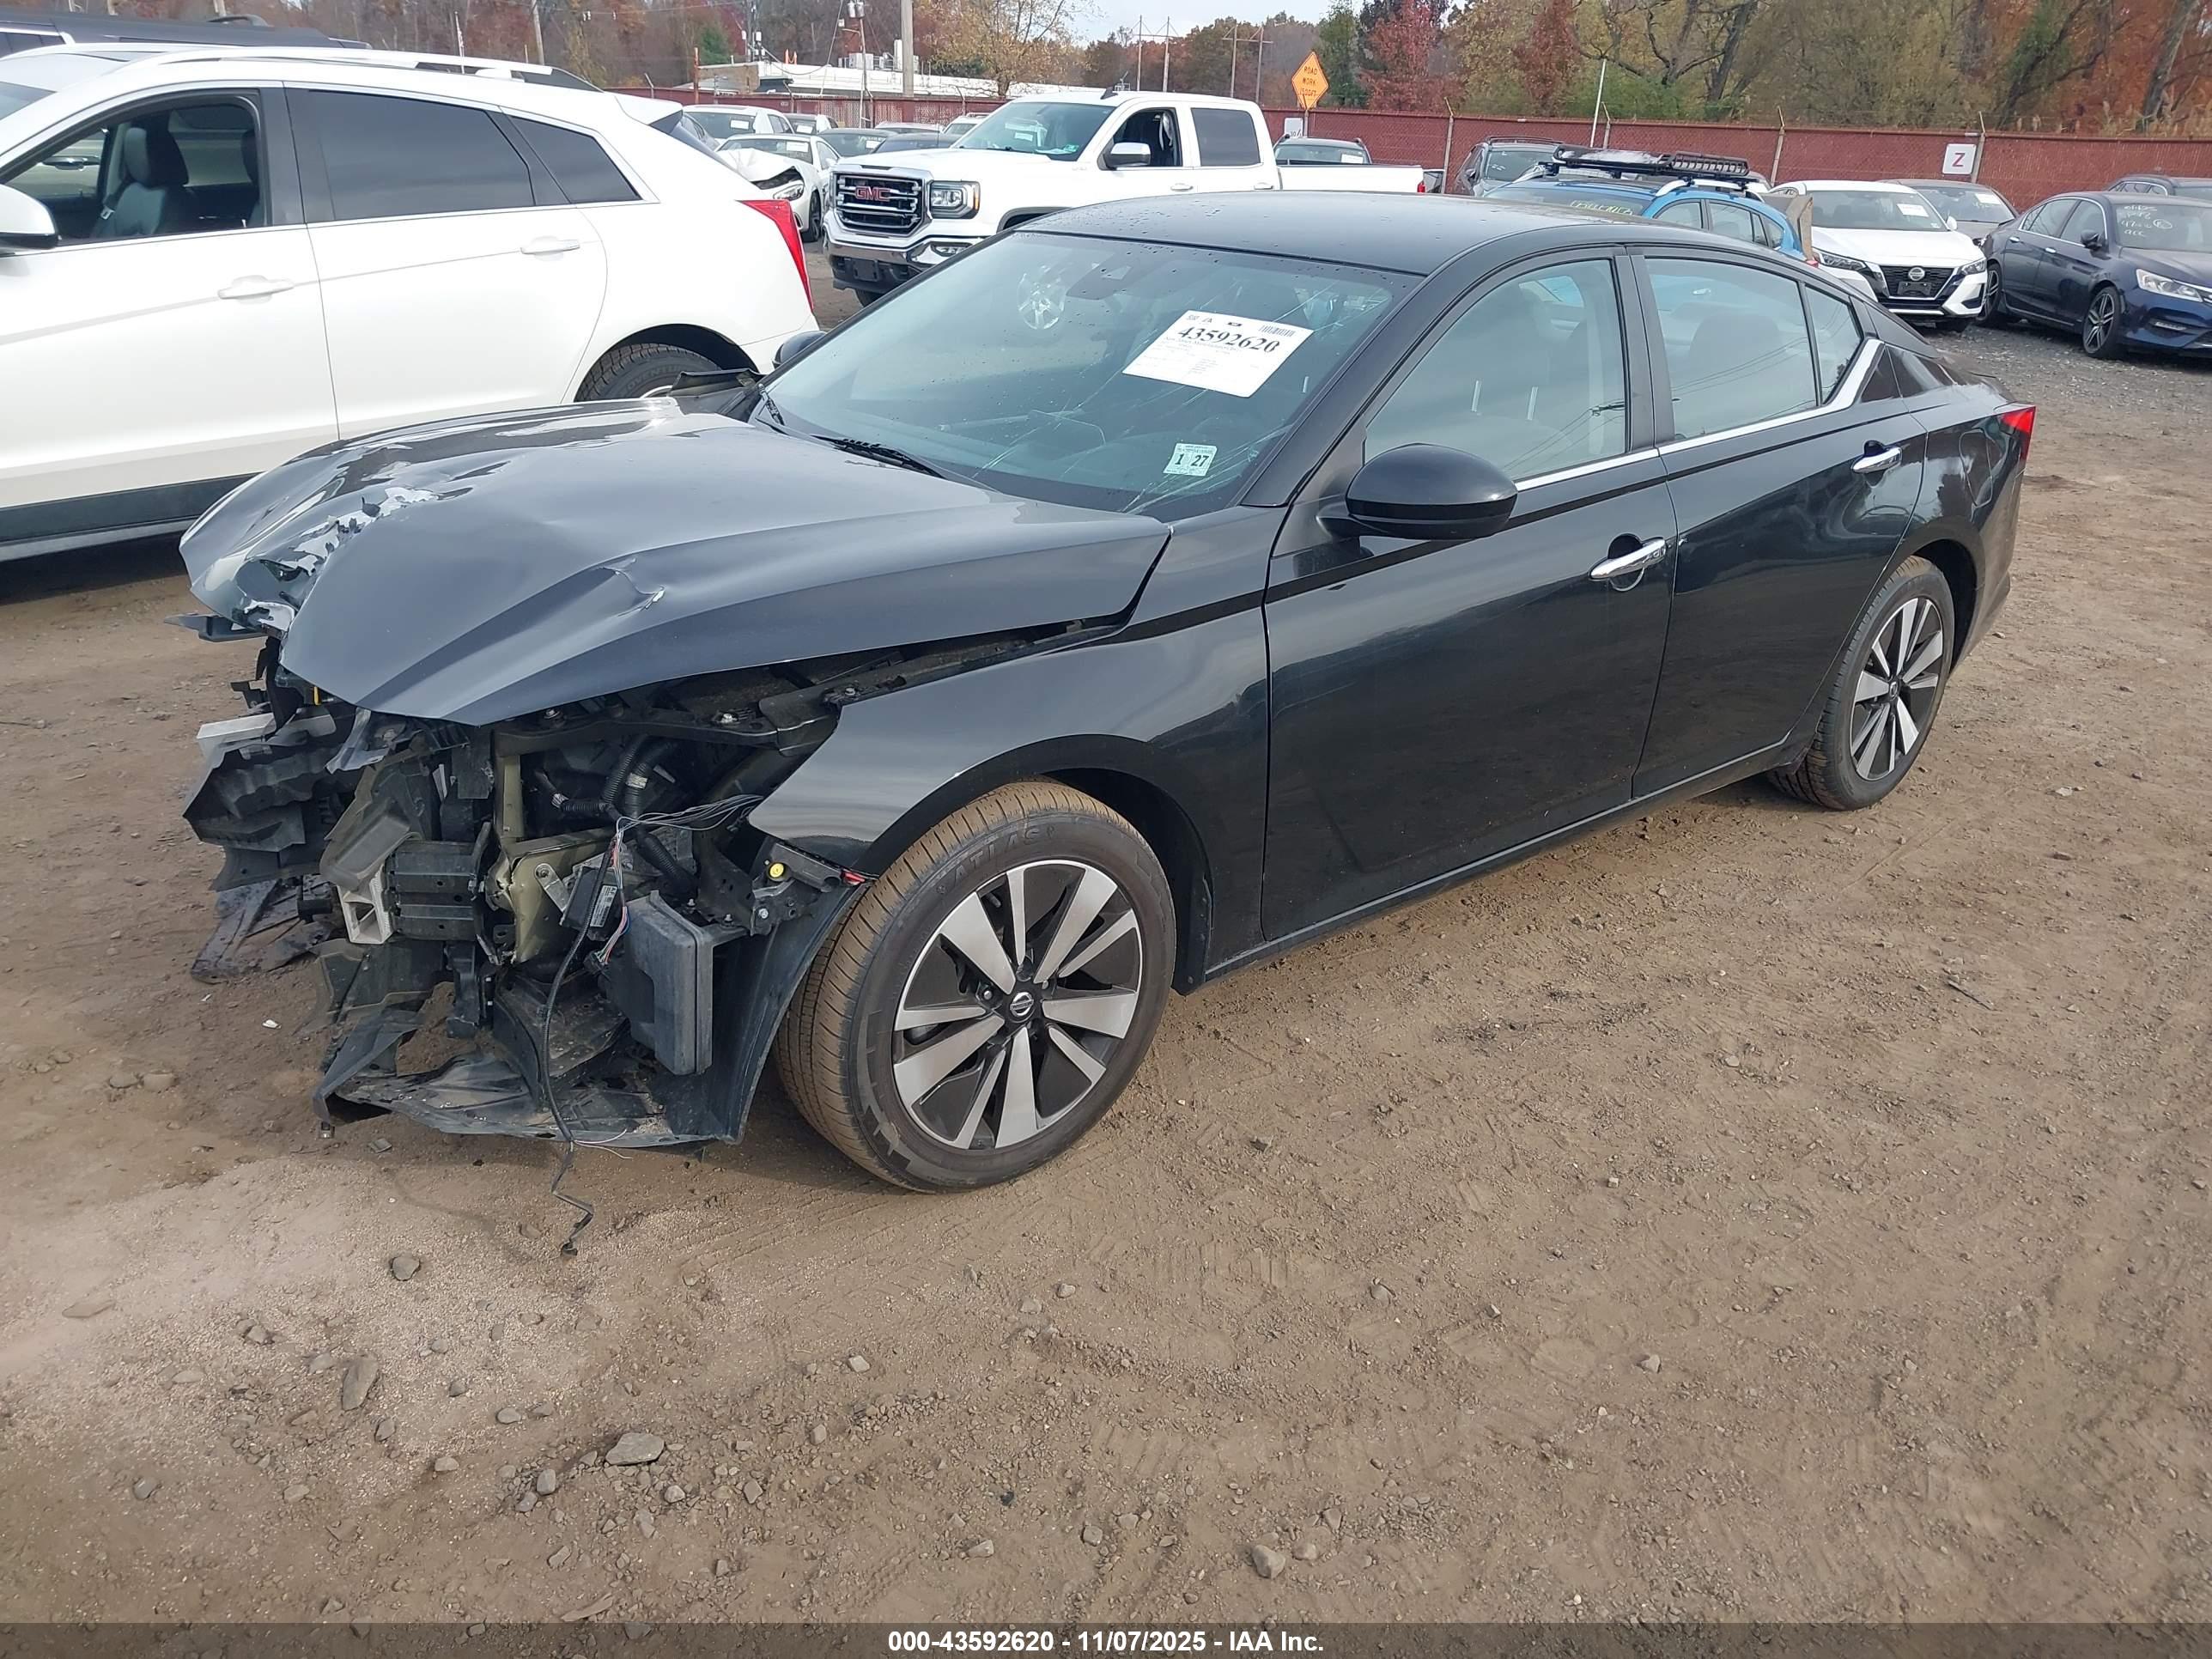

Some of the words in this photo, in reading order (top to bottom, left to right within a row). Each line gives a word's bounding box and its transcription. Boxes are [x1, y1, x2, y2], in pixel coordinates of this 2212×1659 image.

[1304, 66, 1317, 76] ROAD
[1303, 77, 1316, 87] WORK
[1952, 152, 1966, 167] Z
[855, 185, 890, 202] GMC
[1177, 326, 1280, 354] 43592620
[1190, 454, 1210, 467] 27
